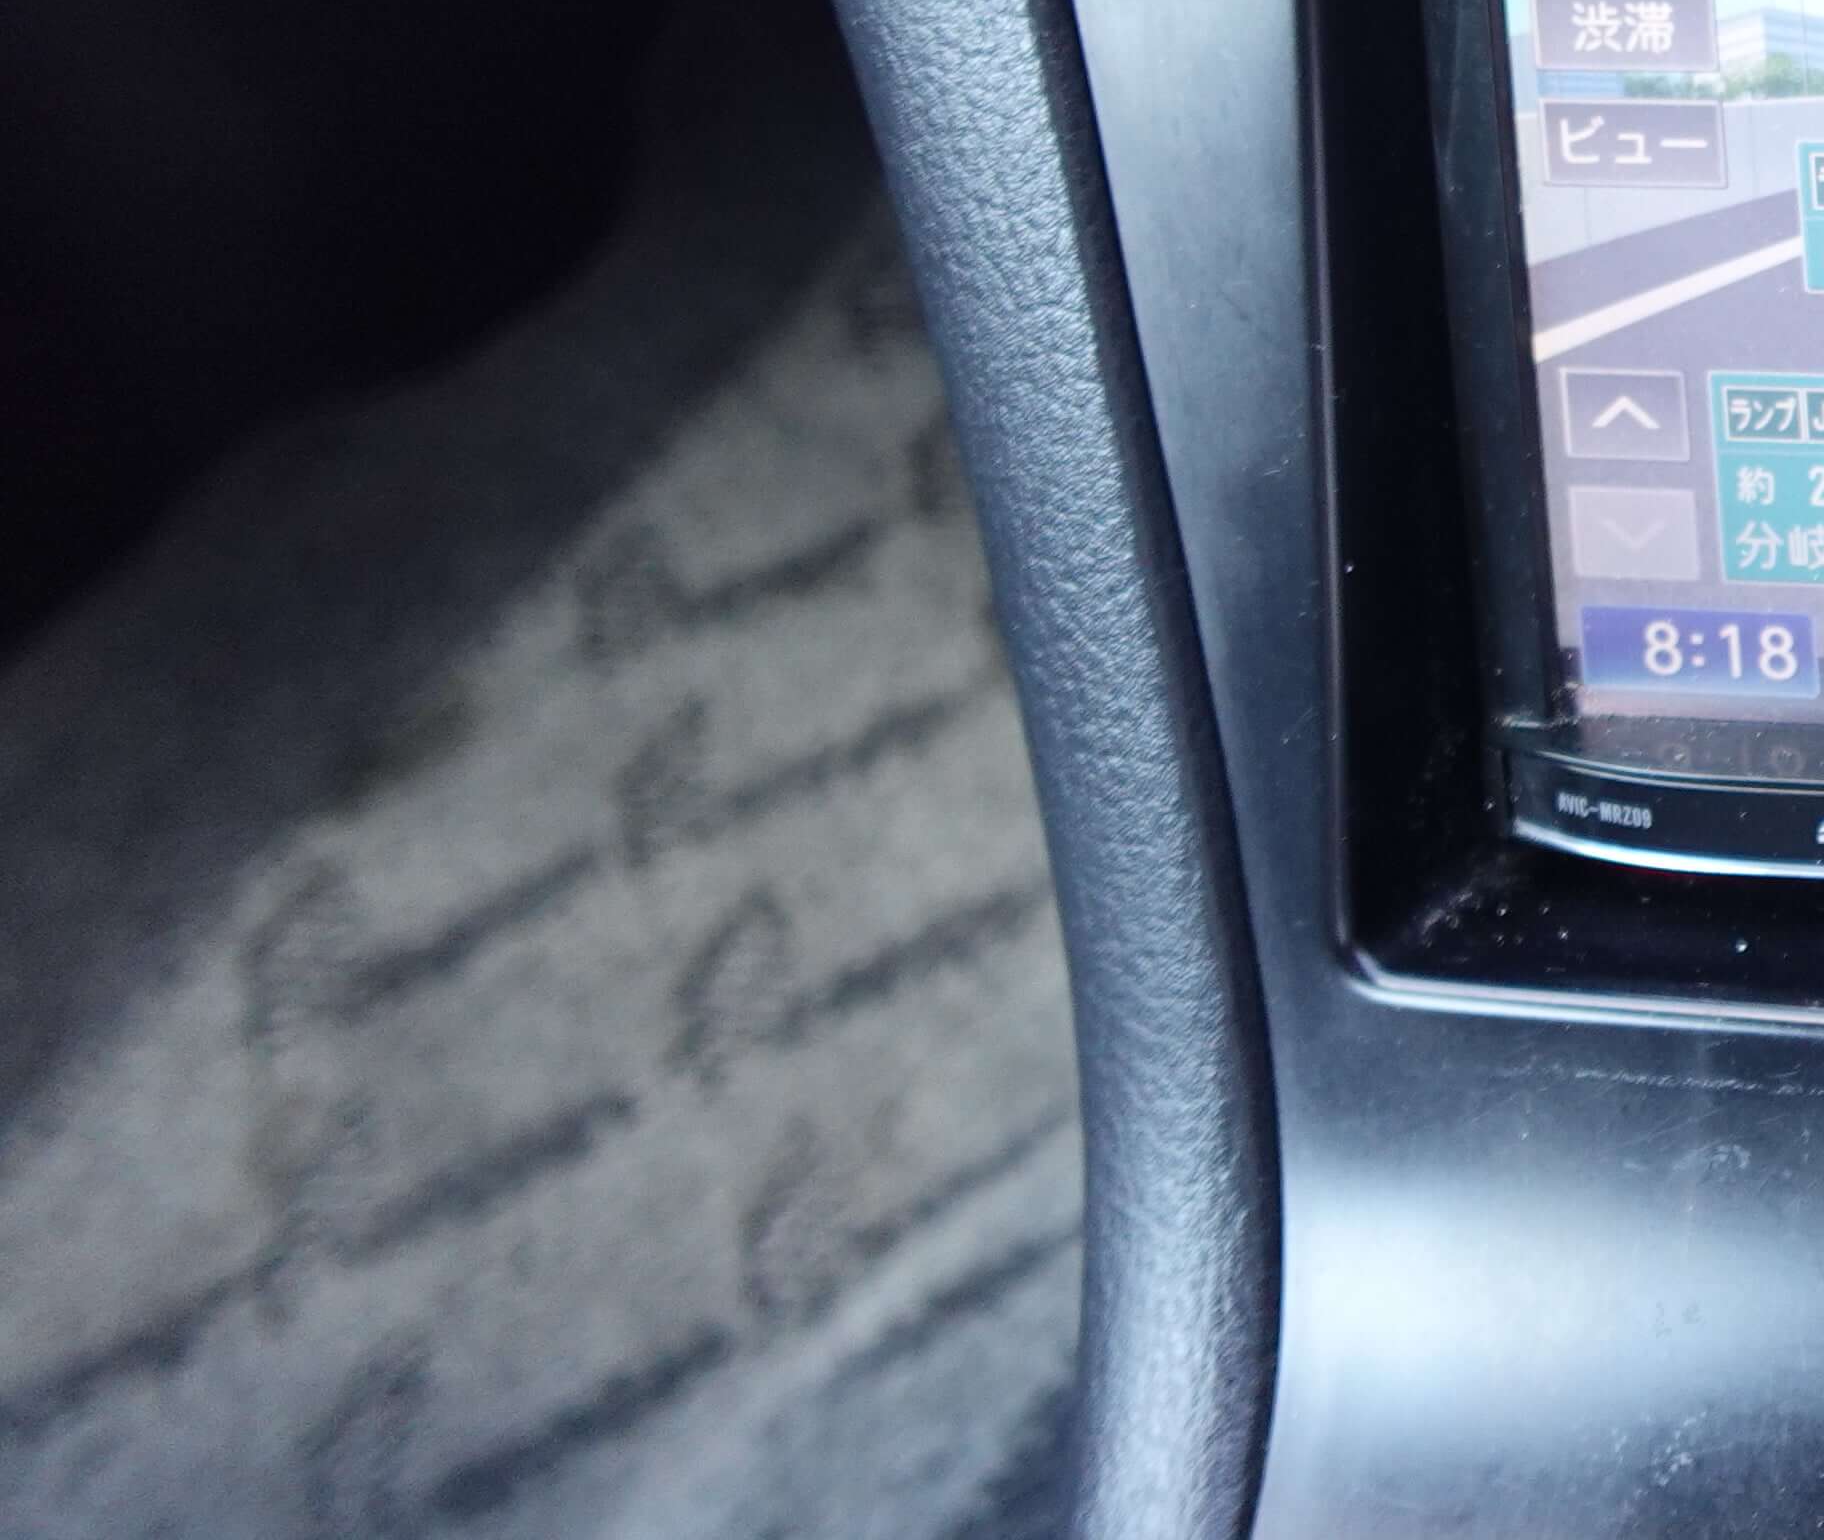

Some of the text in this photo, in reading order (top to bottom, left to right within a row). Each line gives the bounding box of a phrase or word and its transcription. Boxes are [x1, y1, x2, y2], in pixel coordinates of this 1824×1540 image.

[1571, 1, 1676, 54] 渋滞
[1559, 117, 1708, 165] ビュー
[1728, 398, 1798, 432] ランプ
[1736, 468, 1776, 505] 約
[1643, 620, 1799, 682] 8:18
